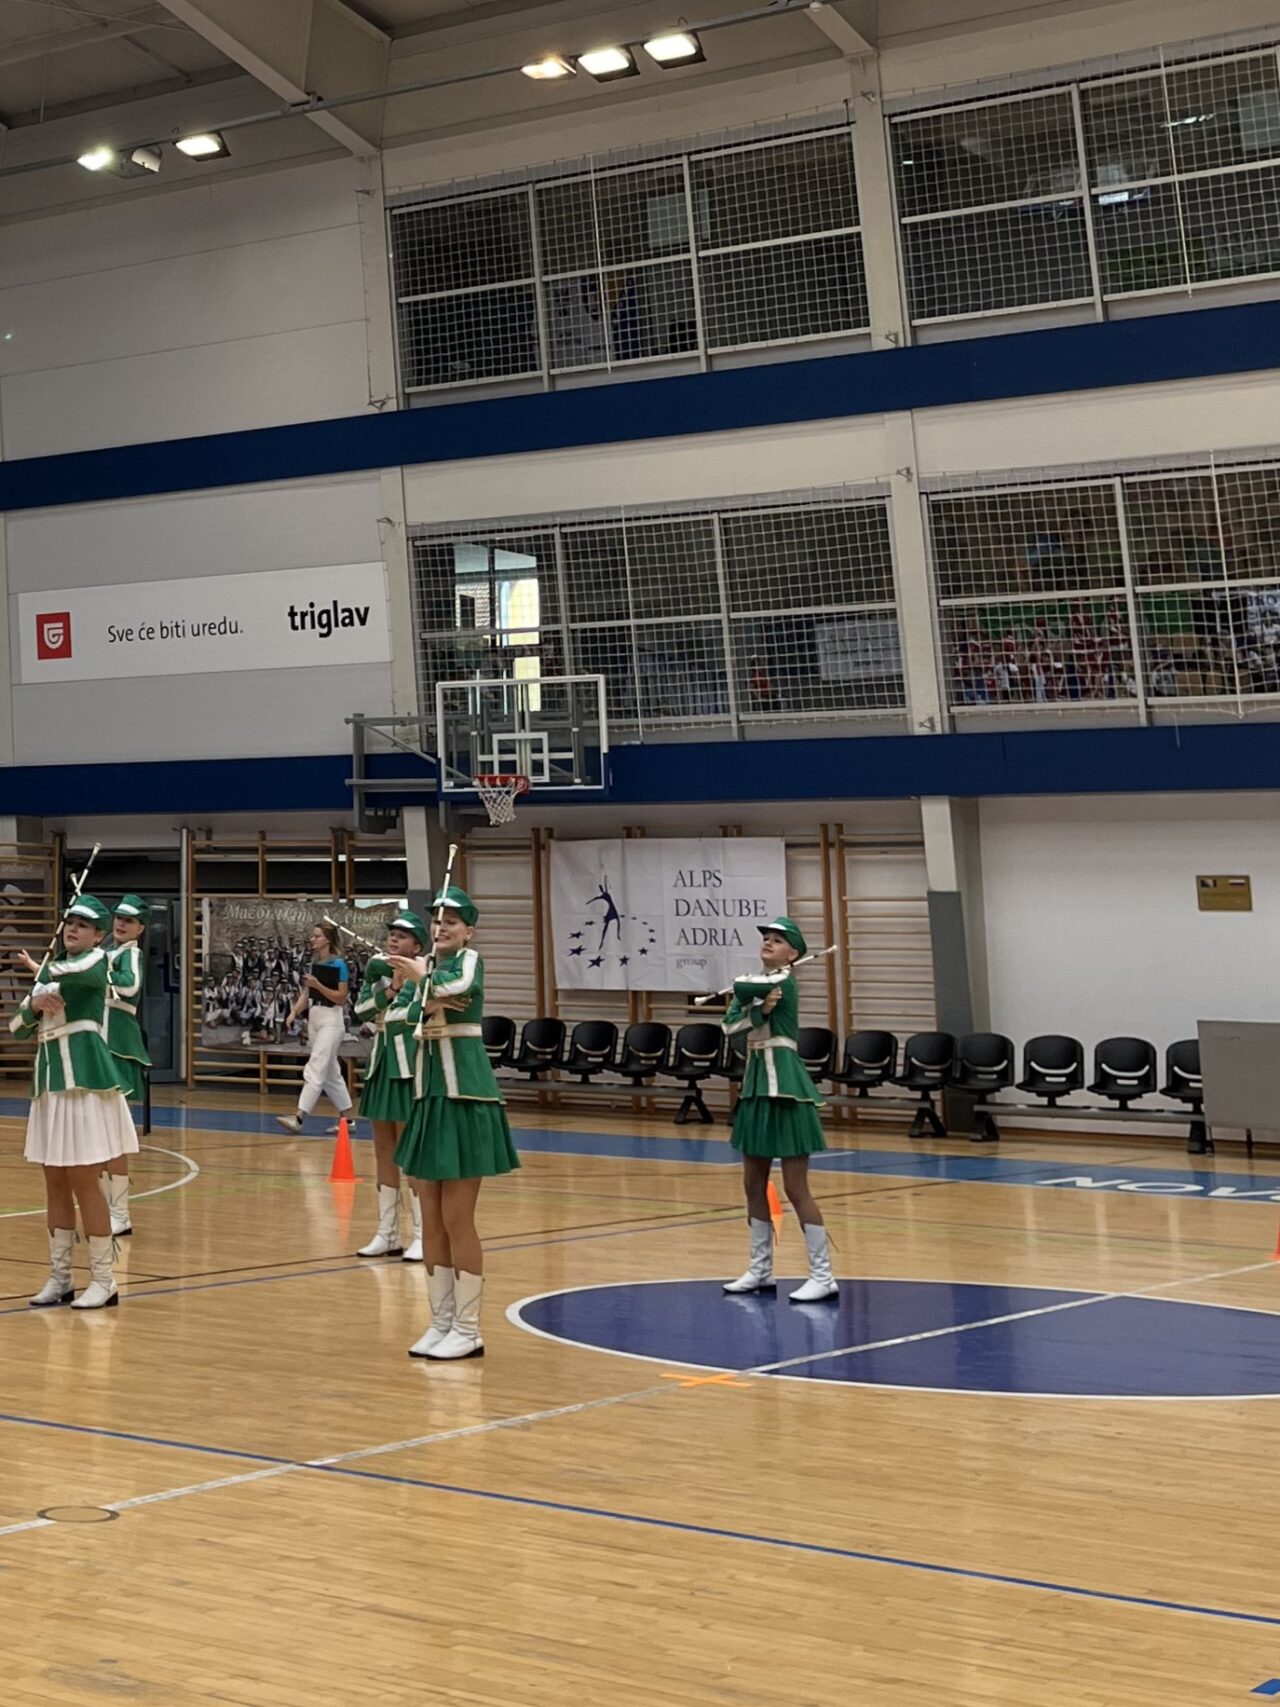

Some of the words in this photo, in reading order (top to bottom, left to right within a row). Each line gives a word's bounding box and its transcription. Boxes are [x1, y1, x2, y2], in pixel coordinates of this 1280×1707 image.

[287, 600, 370, 638] triglav
[107, 624, 134, 643] Sve
[138, 622, 155, 641] će
[160, 619, 186, 639] biti
[191, 616, 243, 637] uredu.
[673, 869, 723, 888] ALPS
[674, 898, 768, 918] DANUBE
[676, 927, 744, 947] ADRIA
[676, 957, 707, 969] group
[1036, 1176, 1280, 1202] NOV
